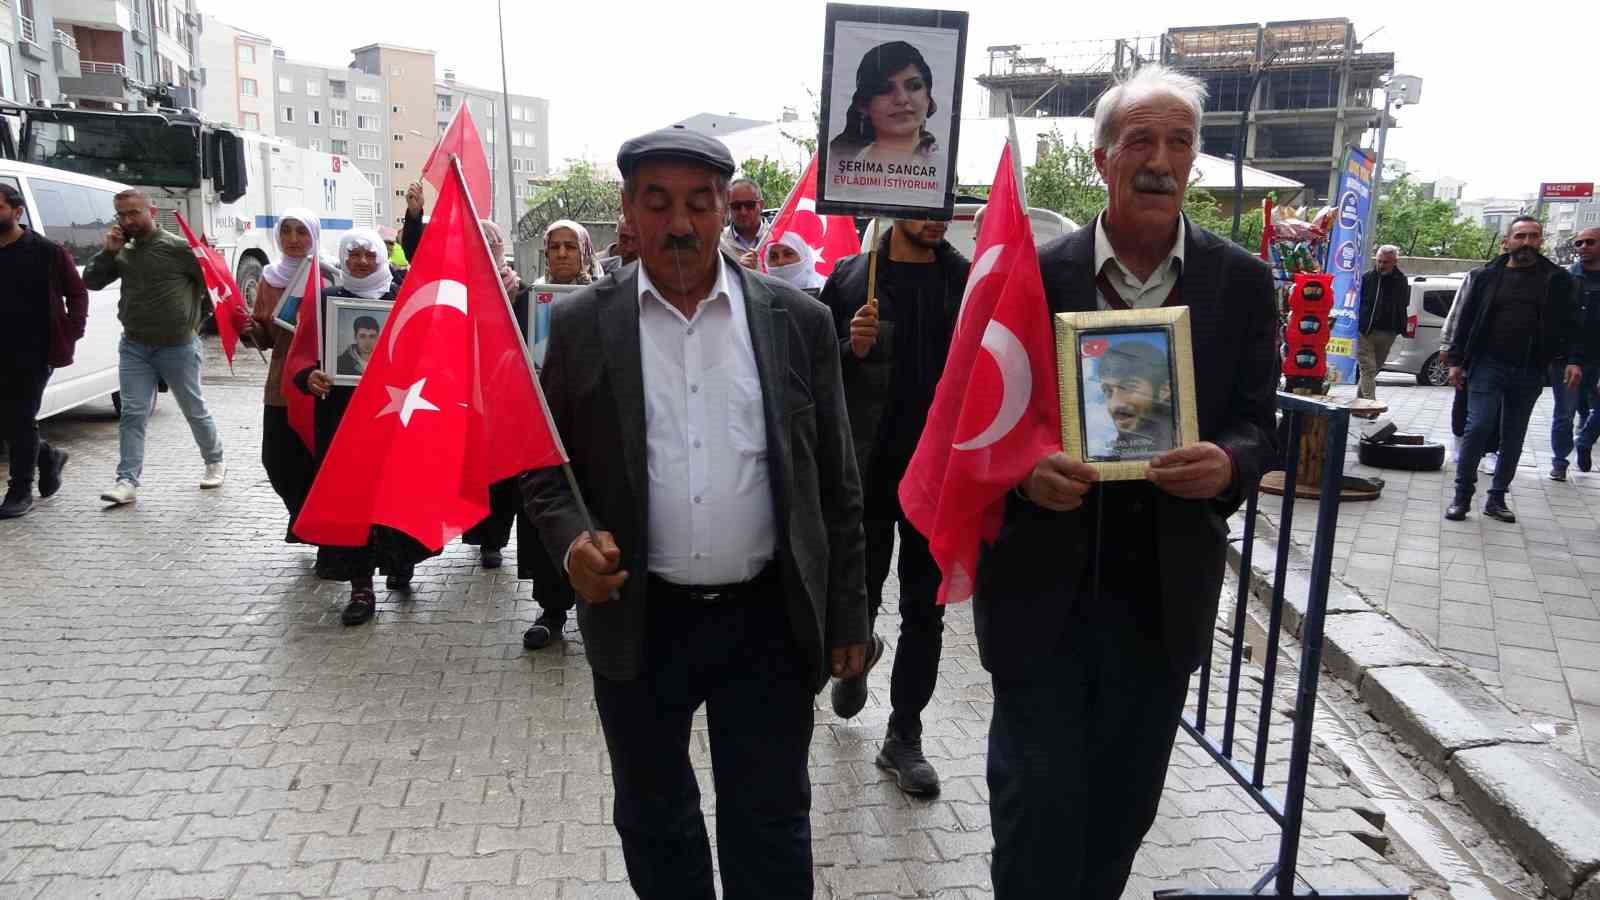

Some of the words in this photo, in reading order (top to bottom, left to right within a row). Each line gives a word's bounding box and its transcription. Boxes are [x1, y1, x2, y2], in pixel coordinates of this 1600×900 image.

[838, 159, 884, 174] ŞERİMA
[887, 163, 937, 177] SANCAR
[833, 175, 881, 187] EVLADIMI
